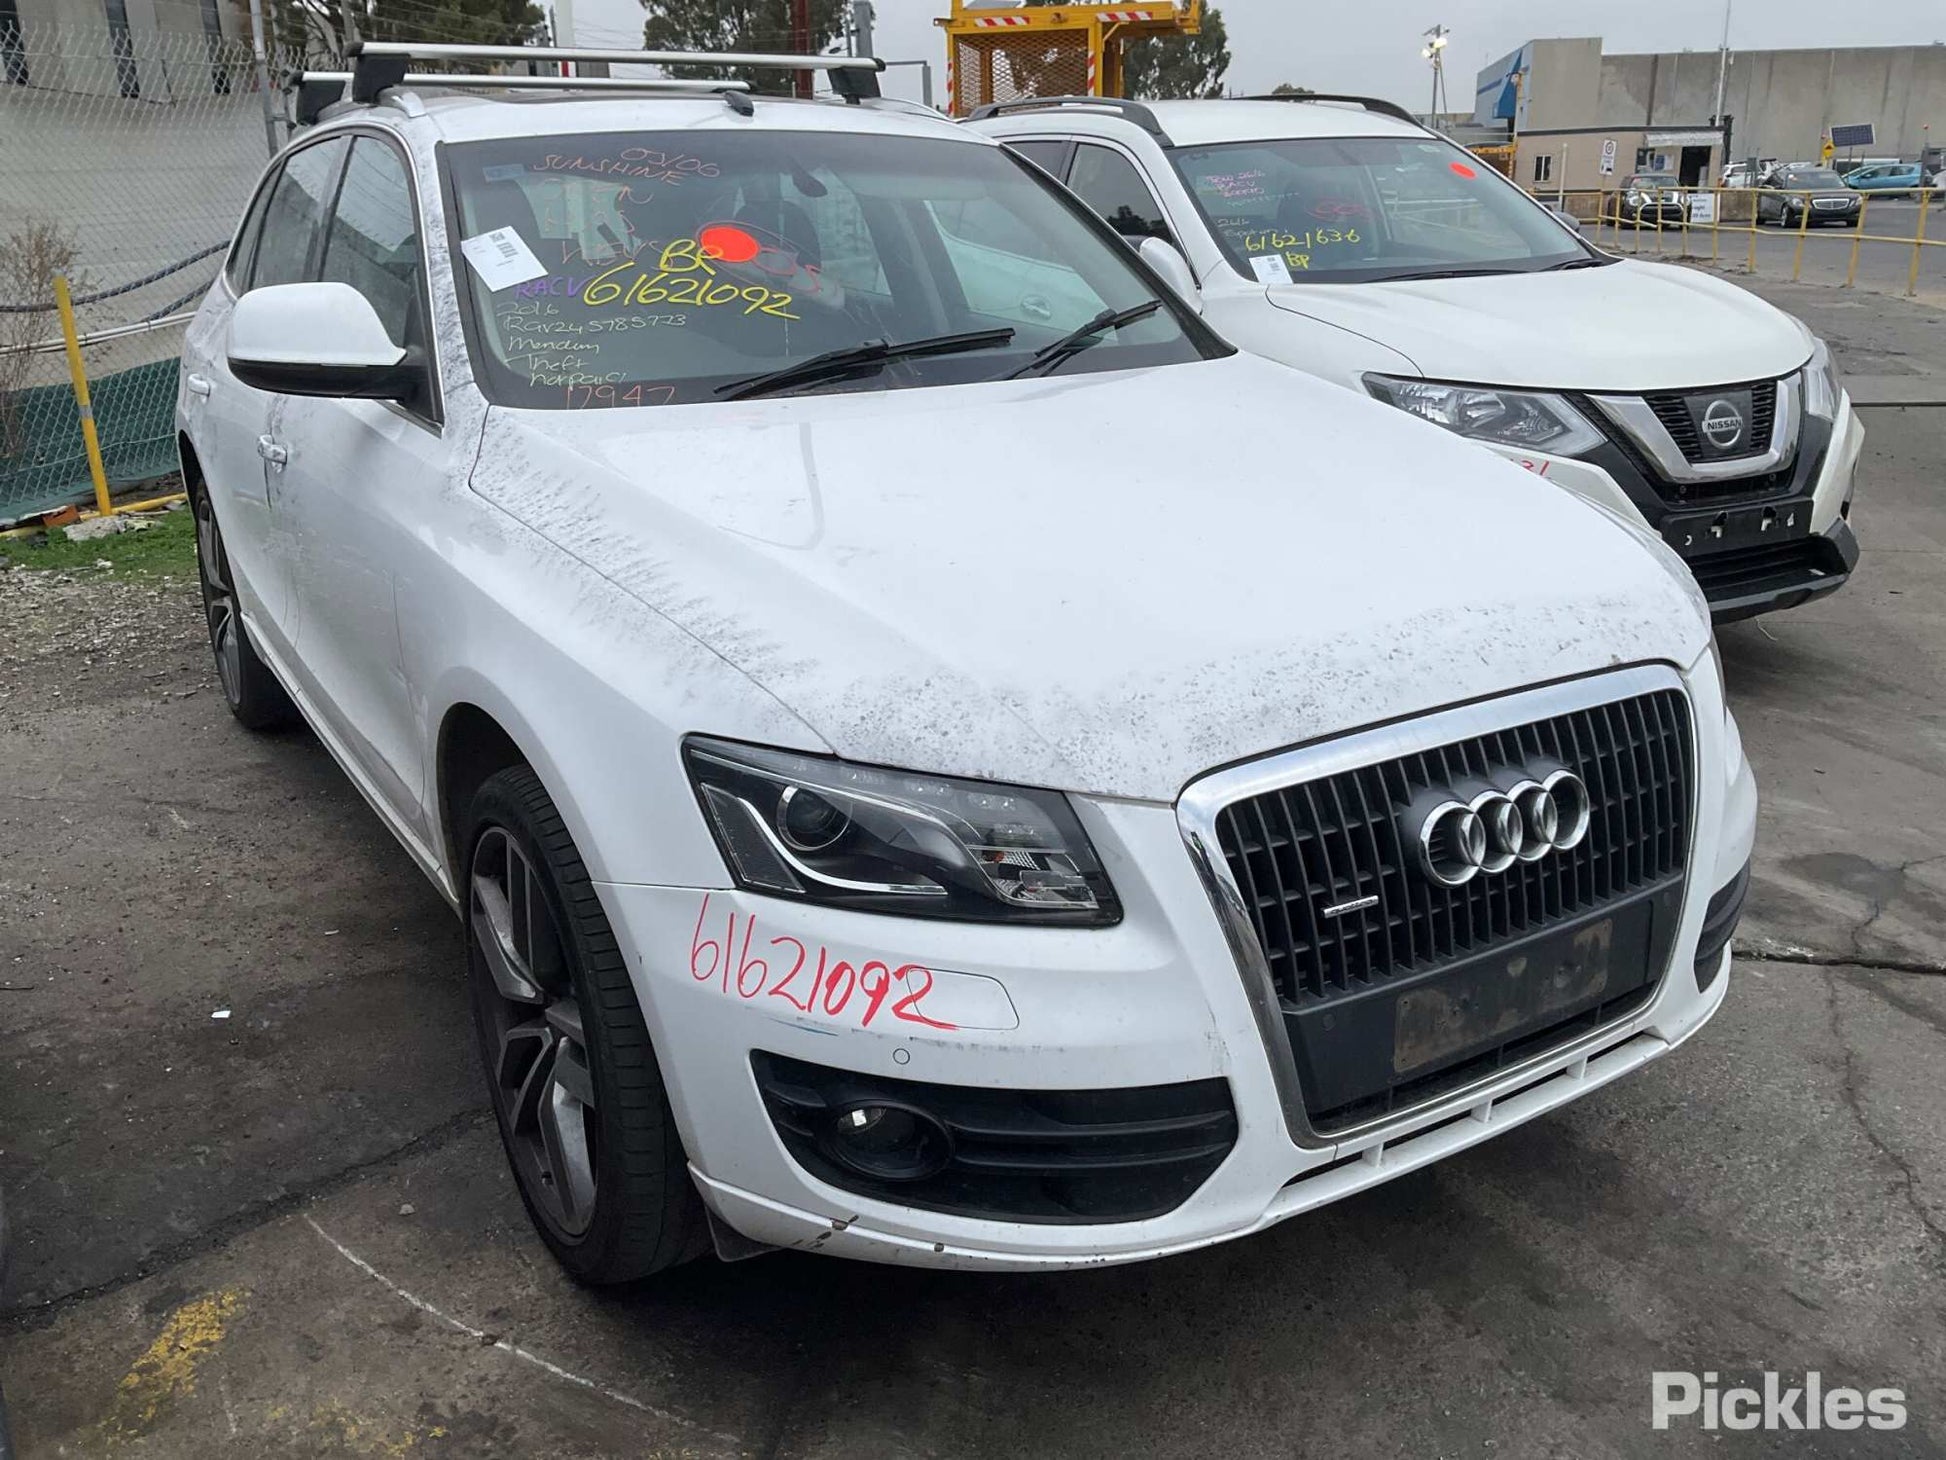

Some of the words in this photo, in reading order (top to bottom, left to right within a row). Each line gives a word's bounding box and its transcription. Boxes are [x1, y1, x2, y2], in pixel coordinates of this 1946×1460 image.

[533, 154, 687, 187] SUNSHINE
[515, 277, 591, 299] RACV
[584, 262, 801, 319] 61621092
[1707, 419, 1742, 430] NISSAN
[691, 892, 959, 1032] 61621092
